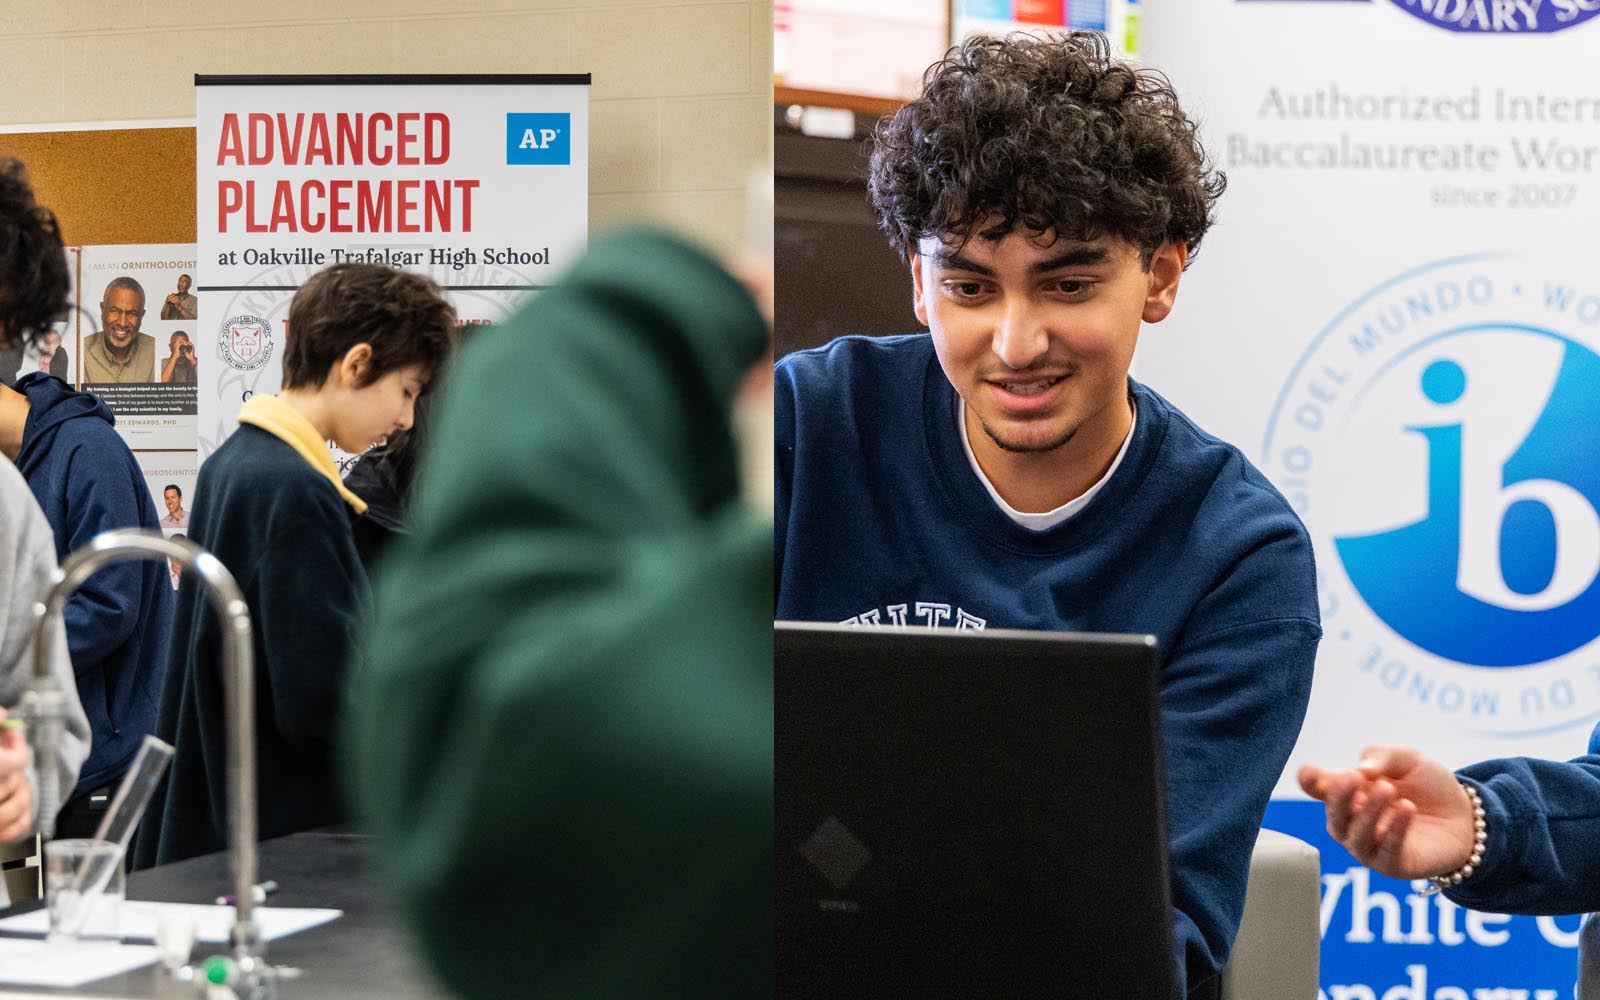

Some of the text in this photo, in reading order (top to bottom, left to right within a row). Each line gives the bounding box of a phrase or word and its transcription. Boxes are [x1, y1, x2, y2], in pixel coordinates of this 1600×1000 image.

[1258, 84, 1480, 121] Authorized
[216, 112, 450, 166] ADVANCED
[1226, 133, 1499, 171] Baccalaureate
[217, 179, 480, 233] PLACEMENT
[1430, 183, 1579, 209] since 2007
[121, 260, 197, 270] ORNITHOLOGIST
[218, 247, 550, 270] at Oakville Trafalgar High School
[1294, 275, 1493, 433] DEL MUNDO
[1359, 644, 1576, 717] DU MONDE
